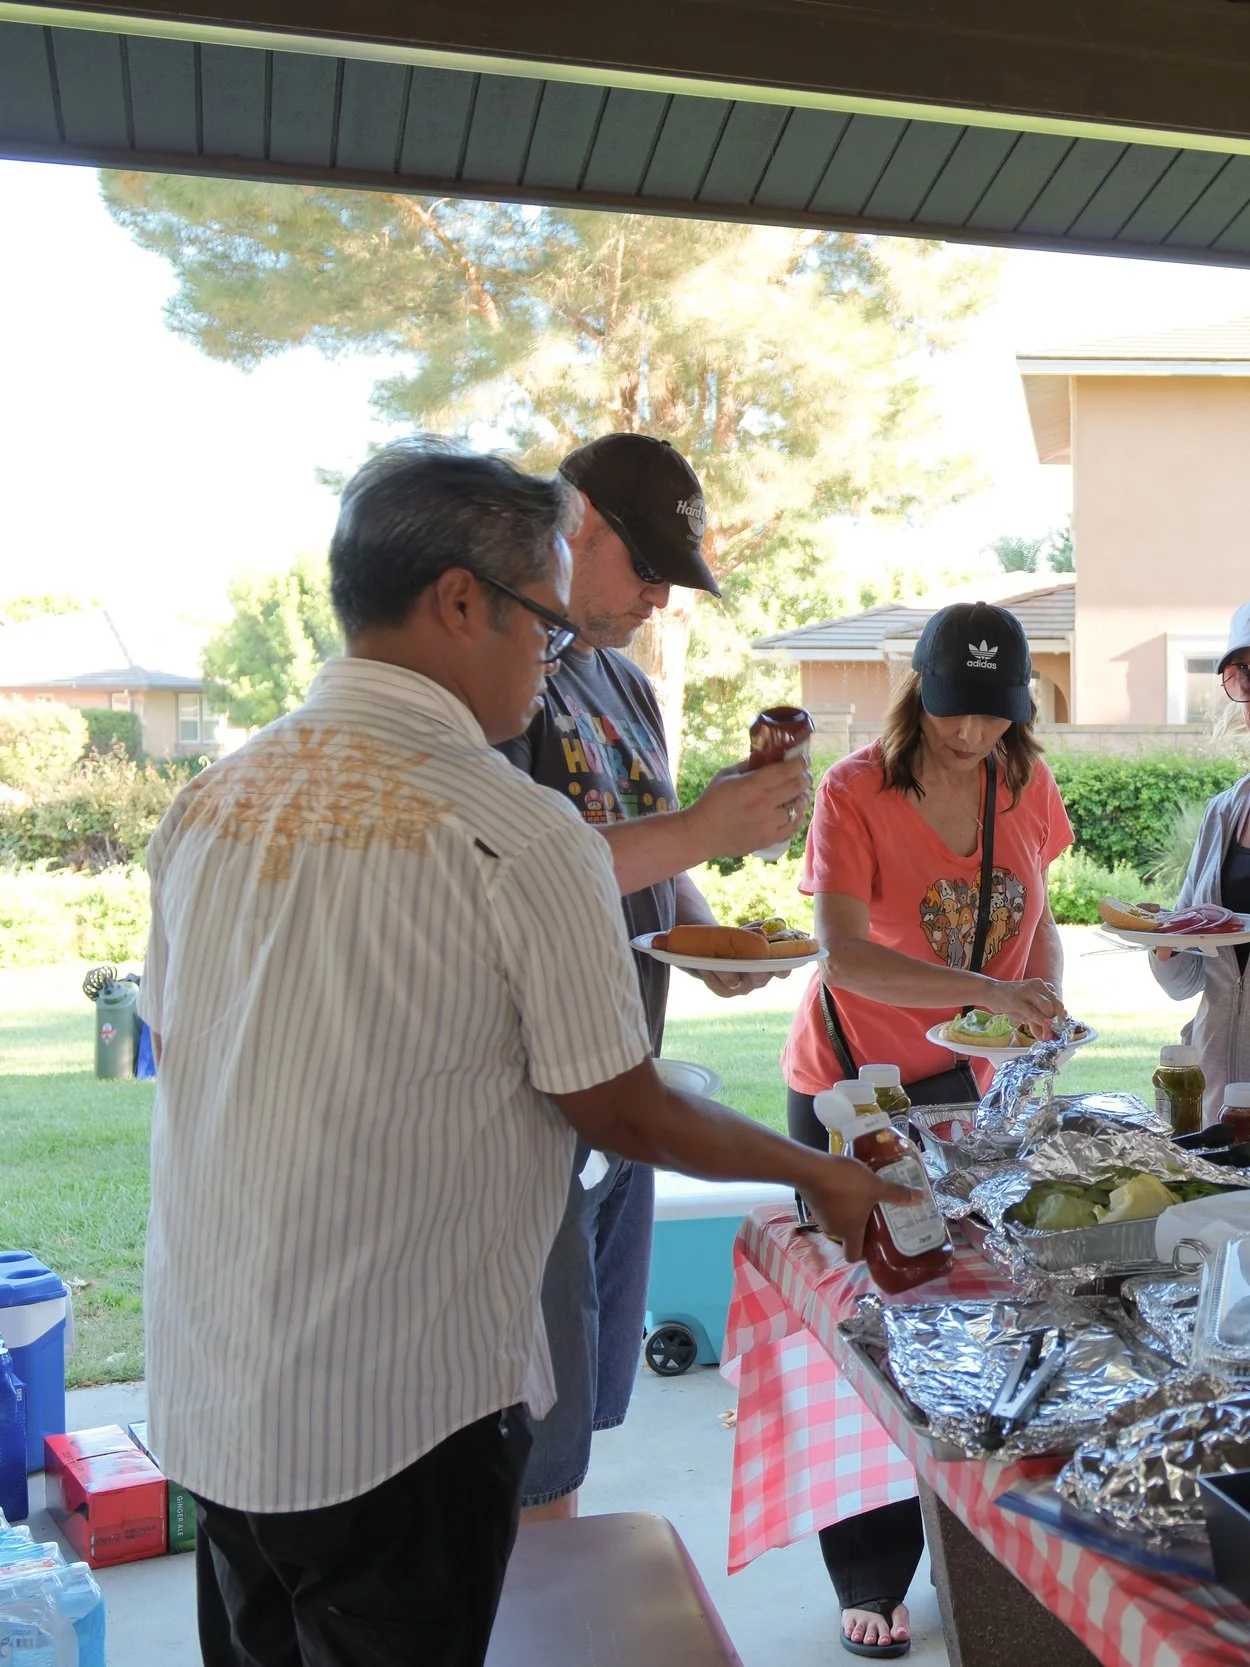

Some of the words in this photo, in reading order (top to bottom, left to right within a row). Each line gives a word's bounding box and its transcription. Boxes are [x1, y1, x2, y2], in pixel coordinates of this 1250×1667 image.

[675, 500, 703, 520] Hard
[966, 660, 997, 670] adidas
[176, 1495, 184, 1523] GINGER
[176, 1524, 184, 1537] ALE
